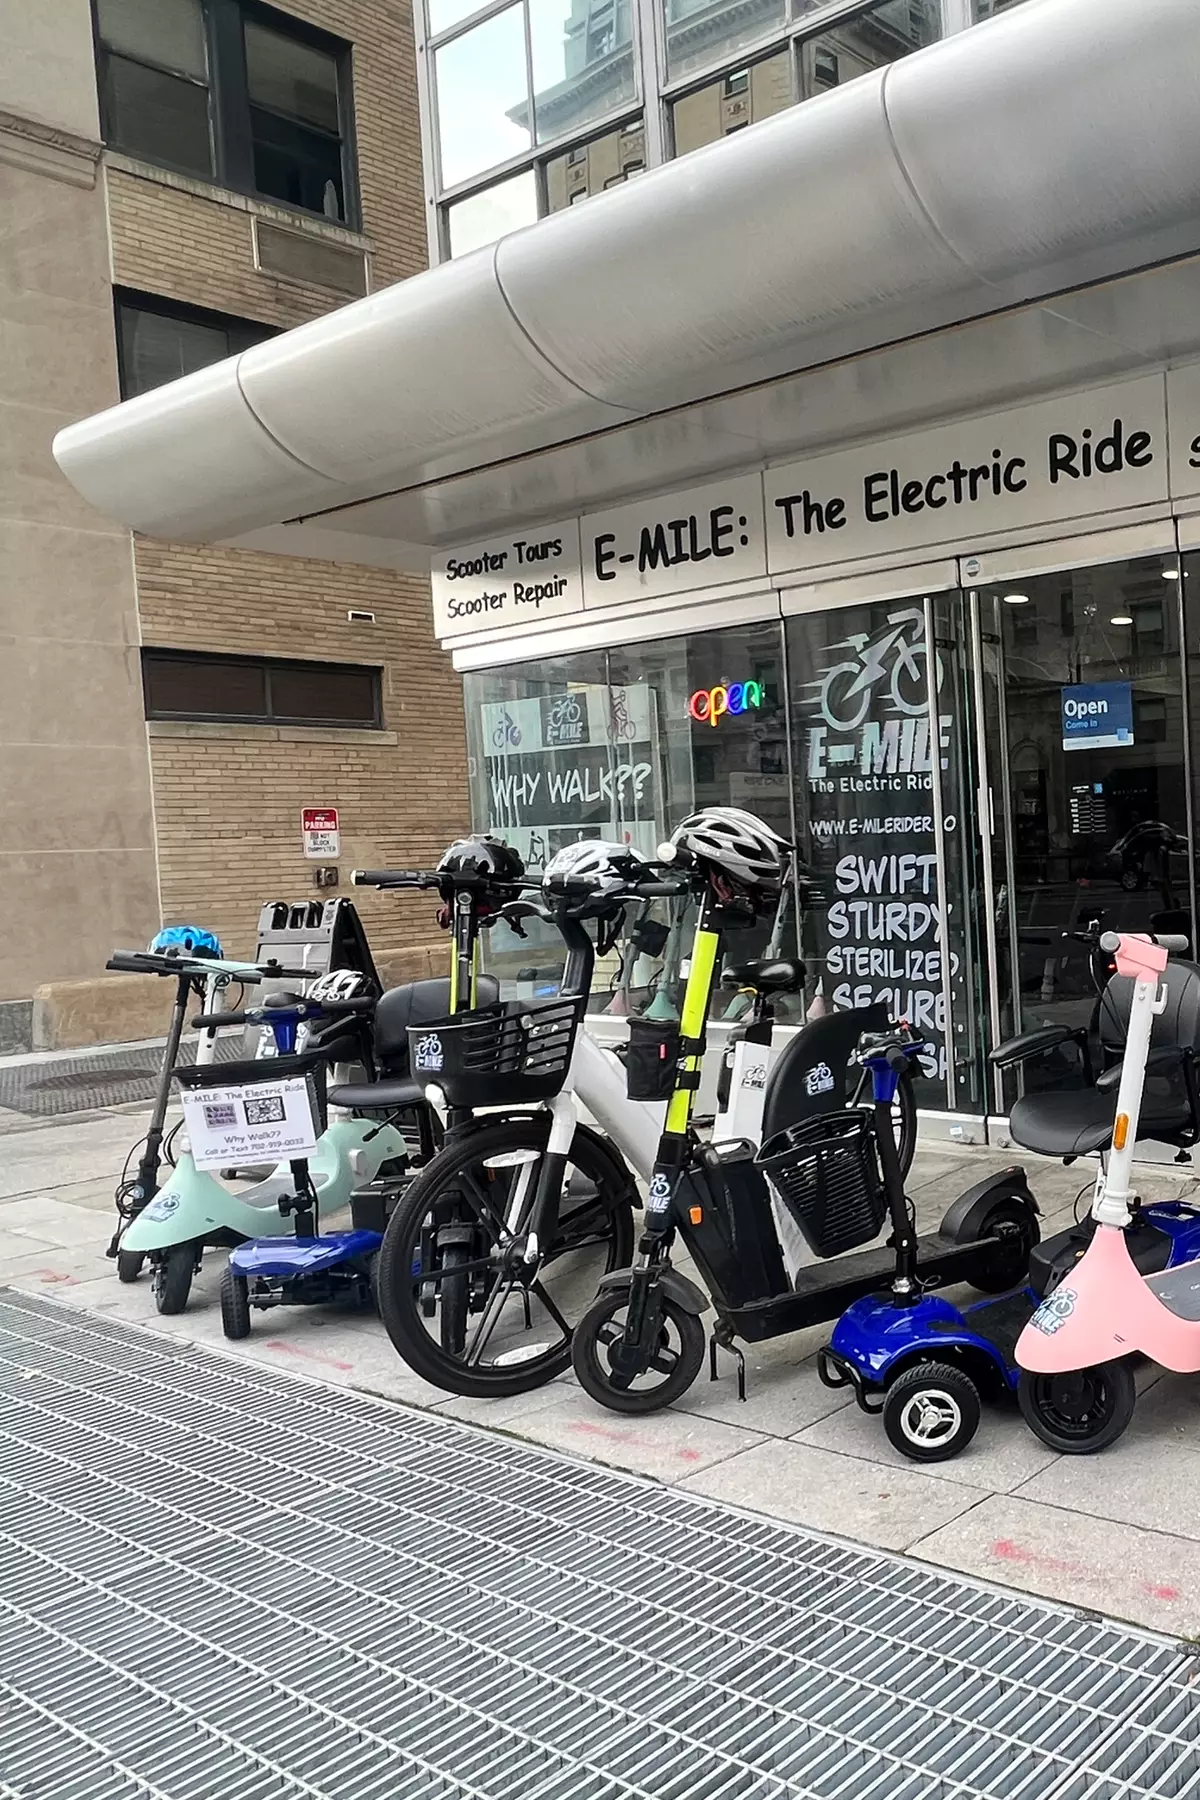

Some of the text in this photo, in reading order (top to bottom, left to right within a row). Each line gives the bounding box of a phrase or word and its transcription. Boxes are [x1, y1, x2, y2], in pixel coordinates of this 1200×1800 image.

[593, 417, 1154, 582] E-MILE: The Electric Ride
[446, 538, 563, 581] Scooter Tours
[447, 574, 568, 619] Scooter Repair
[689, 680, 763, 728] open
[1064, 699, 1109, 720] Open
[490, 761, 652, 809] WHY WALK??
[807, 778, 836, 794] The
[840, 773, 902, 792] Electric
[906, 772, 933, 791] Rid
[808, 814, 957, 837] WWW.E-MILERIDER.O
[244, 1086, 283, 1099] Electric
